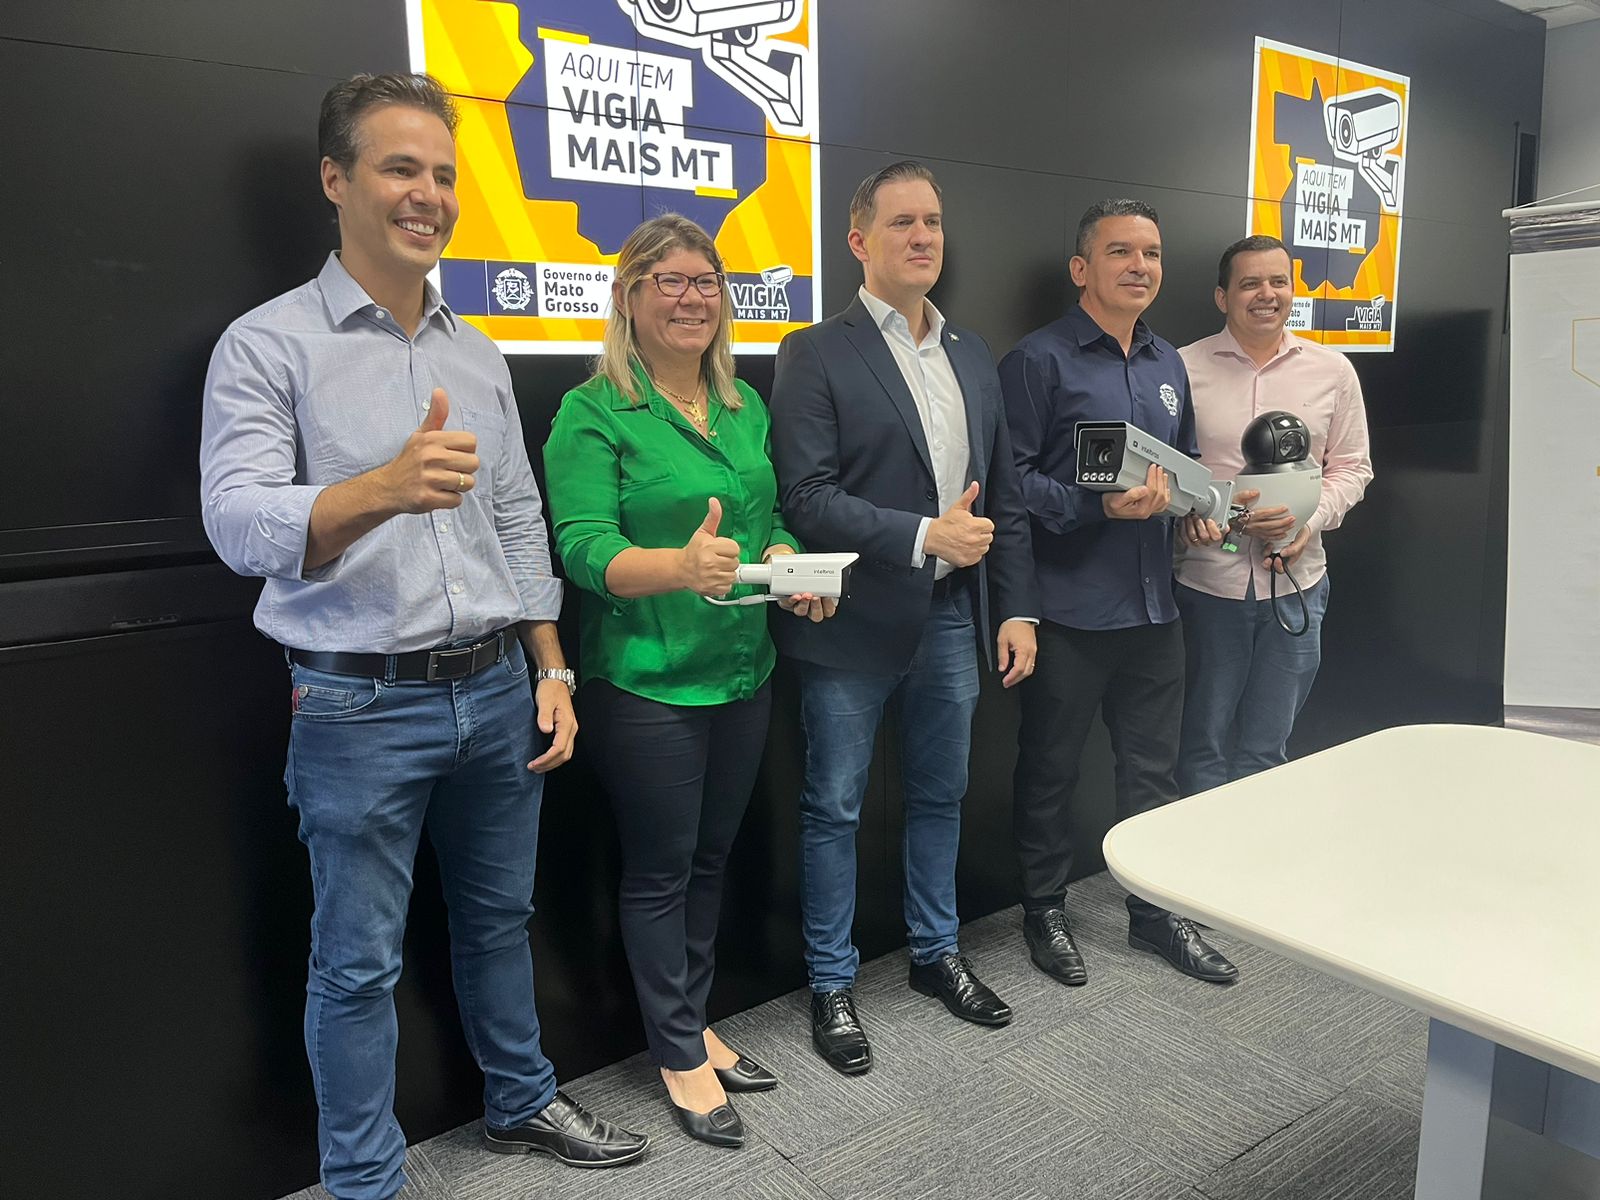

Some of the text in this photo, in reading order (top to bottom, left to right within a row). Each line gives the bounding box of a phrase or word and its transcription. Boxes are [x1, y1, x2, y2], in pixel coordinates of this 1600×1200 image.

[561, 52, 673, 91] AQUI TEM
[562, 86, 666, 134] VIGIA
[568, 134, 720, 182] MAIS MT
[1302, 169, 1347, 190] AQUI TEM
[1302, 190, 1341, 216] VIGIA
[1300, 218, 1361, 244] MAIS MT
[543, 268, 609, 282] Governo de
[545, 281, 584, 297] Mato
[731, 285, 788, 307] VIGIA
[545, 298, 599, 313] Grosso
[737, 309, 786, 320] MAIS MT
[1359, 308, 1381, 322] VIGIA
